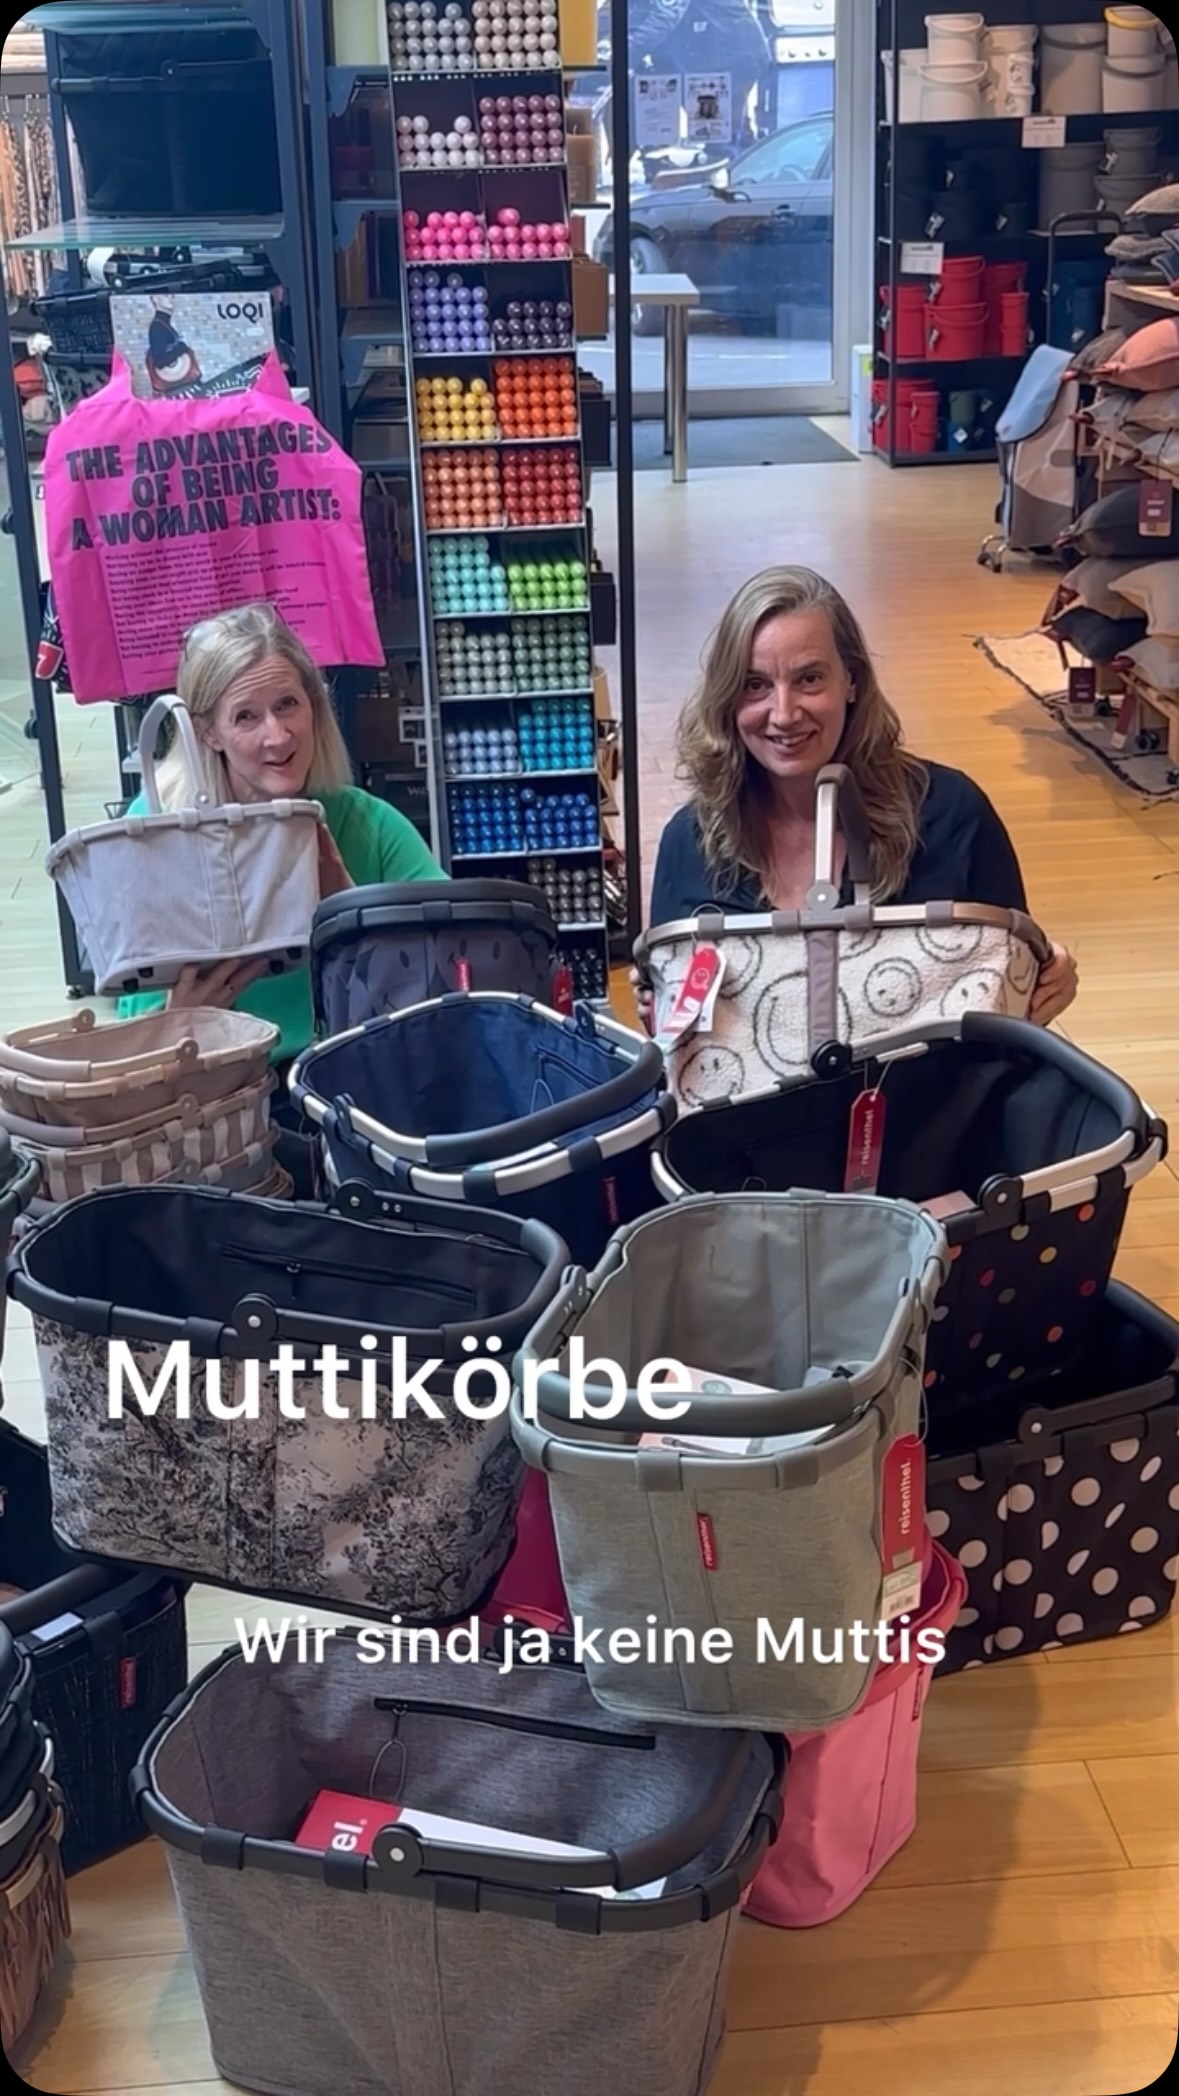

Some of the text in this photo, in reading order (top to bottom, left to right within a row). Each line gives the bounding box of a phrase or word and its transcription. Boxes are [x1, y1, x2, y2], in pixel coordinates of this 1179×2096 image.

[217, 302, 264, 324] LOQI
[65, 420, 333, 482] THE ADVANTAGES
[131, 457, 279, 509] OF BEING
[71, 487, 342, 551] A WOMAN ARTIST:
